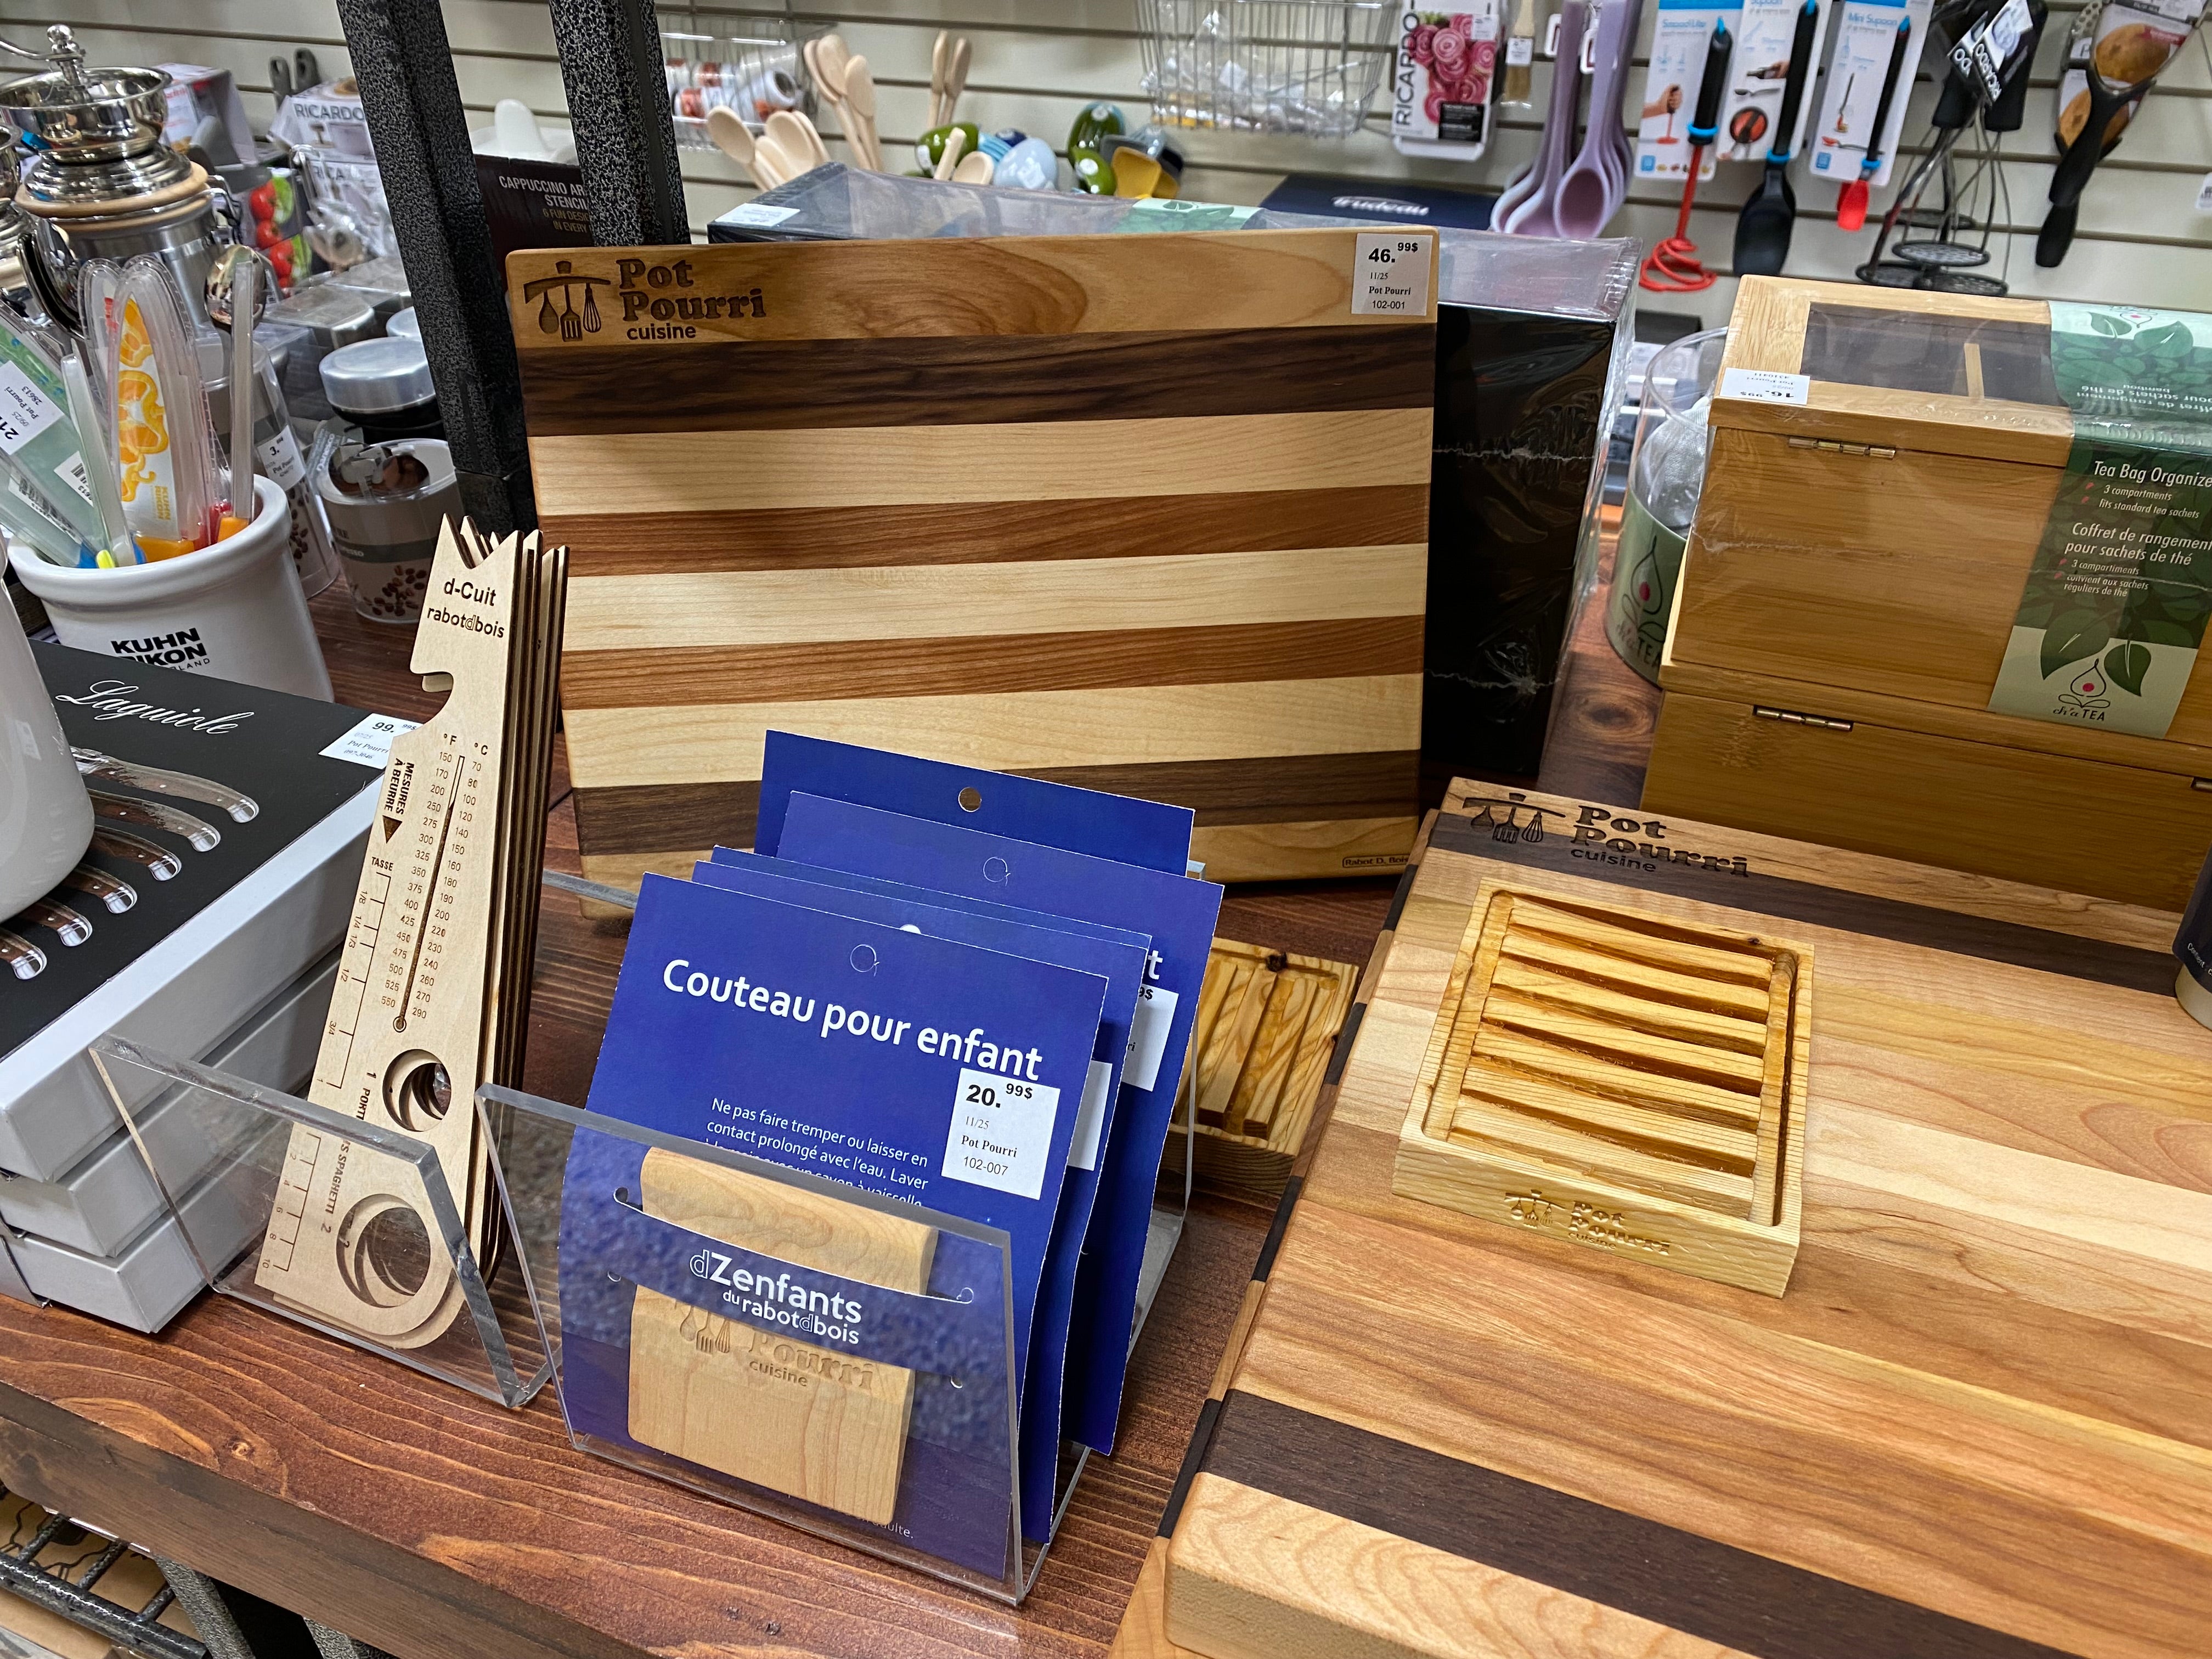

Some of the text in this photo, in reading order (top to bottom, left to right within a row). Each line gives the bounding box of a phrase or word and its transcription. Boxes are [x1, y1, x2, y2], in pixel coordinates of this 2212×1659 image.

[1396, 12, 1420, 126] RICARDO
[294, 103, 364, 121] RICARDO
[498, 176, 567, 194] CAPPUCCINO
[550, 208, 566, 219] FUN
[553, 221, 587, 233] IN EVERY
[1368, 242, 1418, 263] 46. 99$
[616, 258, 694, 289] Pot
[1370, 272, 1389, 280] 11/25
[1369, 286, 1411, 295] Pot Pourri
[619, 288, 766, 321] Pourri
[1372, 300, 1406, 309] 102-001
[627, 323, 696, 340] cuisine
[2123, 384, 2170, 393] bambou
[2129, 390, 2179, 400] sachets
[21, 386, 43, 405] 28613
[2077, 392, 2152, 405] rangement
[4, 386, 40, 420] Pot Pourri
[12, 411, 30, 427] 09/25
[2094, 460, 2147, 483] Tea Bag
[2103, 484, 2173, 501] 3 compartments
[2099, 498, 2201, 519] fits standard tea sachets
[2072, 522, 2117, 539] Coffret
[2119, 527, 2136, 541] de
[2064, 542, 2193, 566] pour sachets de thé
[2072, 558, 2140, 575] 3 compartiments
[2064, 583, 2129, 598] réguliers de thé
[2102, 578, 2118, 587] aux
[2119, 579, 2149, 591] sachets
[443, 578, 496, 606] d-Cuit
[427, 607, 505, 638] rabotdbois
[111, 627, 201, 654] KUHN
[55, 680, 255, 734] Laguiole
[2082, 709, 2106, 721] TEA
[372, 722, 394, 733] 99.
[347, 740, 390, 754] Pot Pourri
[439, 751, 452, 763] 150
[472, 761, 482, 772] 70
[435, 768, 449, 780] 170
[384, 769, 402, 812] BEURRE
[395, 762, 415, 815] MESURES
[430, 784, 445, 796] 200
[427, 800, 441, 812] 250
[463, 794, 476, 806] 100
[423, 817, 438, 829] 275
[459, 811, 472, 822] 120
[1576, 805, 1667, 839] Pot
[419, 833, 434, 845] 300
[455, 827, 469, 839] 140
[415, 849, 430, 861] 325
[452, 844, 465, 855] 150
[1571, 825, 1749, 878] Pourri
[371, 856, 394, 871] TASSE
[448, 860, 461, 872] 160
[1571, 849, 1657, 872] cuisine
[411, 866, 426, 878] 350
[408, 882, 422, 894] 375
[444, 877, 457, 888] 180
[359, 890, 368, 904] 1/8
[440, 893, 453, 905] 190
[404, 898, 419, 911] 400
[400, 915, 415, 927] 425
[435, 909, 450, 921] 200
[353, 916, 362, 929] 1/4
[396, 932, 411, 943] 450
[431, 926, 446, 938] 220
[348, 935, 357, 949] 1/3
[427, 942, 442, 953] 230
[392, 947, 408, 960] 475
[388, 963, 403, 975] 500
[424, 958, 438, 970] 240
[341, 969, 349, 982] 1/2
[420, 974, 435, 986] 260
[385, 979, 400, 992] 525
[381, 996, 396, 1008] 550
[416, 991, 431, 1003] 270
[412, 1007, 427, 1019] 290
[663, 959, 1043, 1081] Couteau pour enfant
[966, 1083, 1034, 1108] 20. 99$
[966, 1116, 990, 1130] 11/25
[712, 1097, 928, 1167] Ne pas faire tremper ou laisser en
[961, 1135, 1018, 1158] Pot Pourri
[706, 1121, 757, 1143] contact
[757, 1134, 818, 1161] prolongé
[820, 1151, 850, 1169] avec
[890, 1168, 929, 1190] Laver
[963, 1156, 1008, 1176] 102-007
[325, 1154, 346, 1214] SPAGHETTI
[1571, 1200, 1625, 1228] Pot
[321, 1222, 332, 1234] 2
[1568, 1215, 1672, 1256] Pourri
[1568, 1232, 1616, 1250] cuisine
[262, 1259, 270, 1268] 10
[690, 1249, 863, 1324] dZenfants
[722, 1290, 860, 1345] du rabotdbois
[748, 1327, 874, 1391] Pourri
[749, 1359, 808, 1387] cuisine
